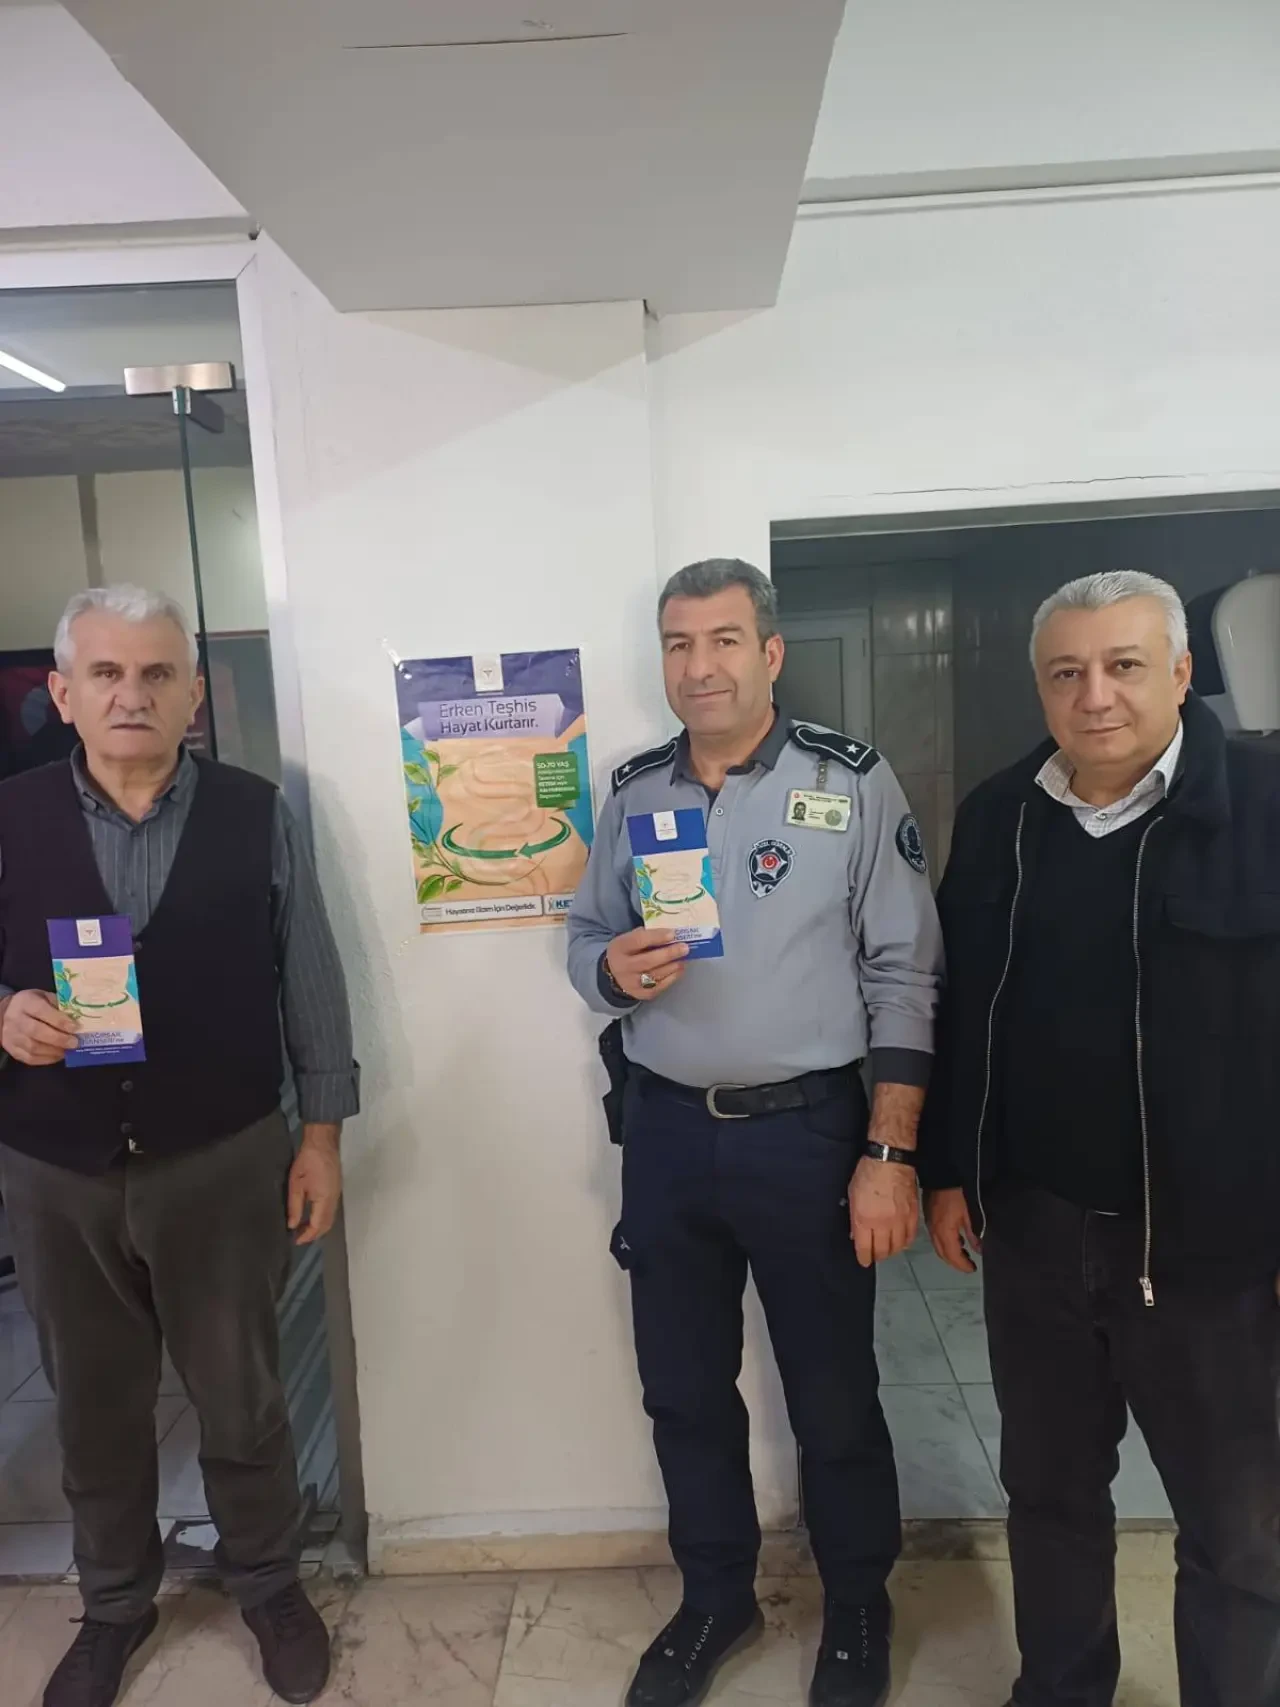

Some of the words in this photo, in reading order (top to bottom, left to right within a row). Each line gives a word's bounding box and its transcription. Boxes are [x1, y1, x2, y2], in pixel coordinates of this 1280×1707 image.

[440, 703, 483, 718] Erken
[487, 698, 537, 717] Teşhis
[440, 721, 482, 736] Hayat
[484, 718, 539, 732] Kurtarır.
